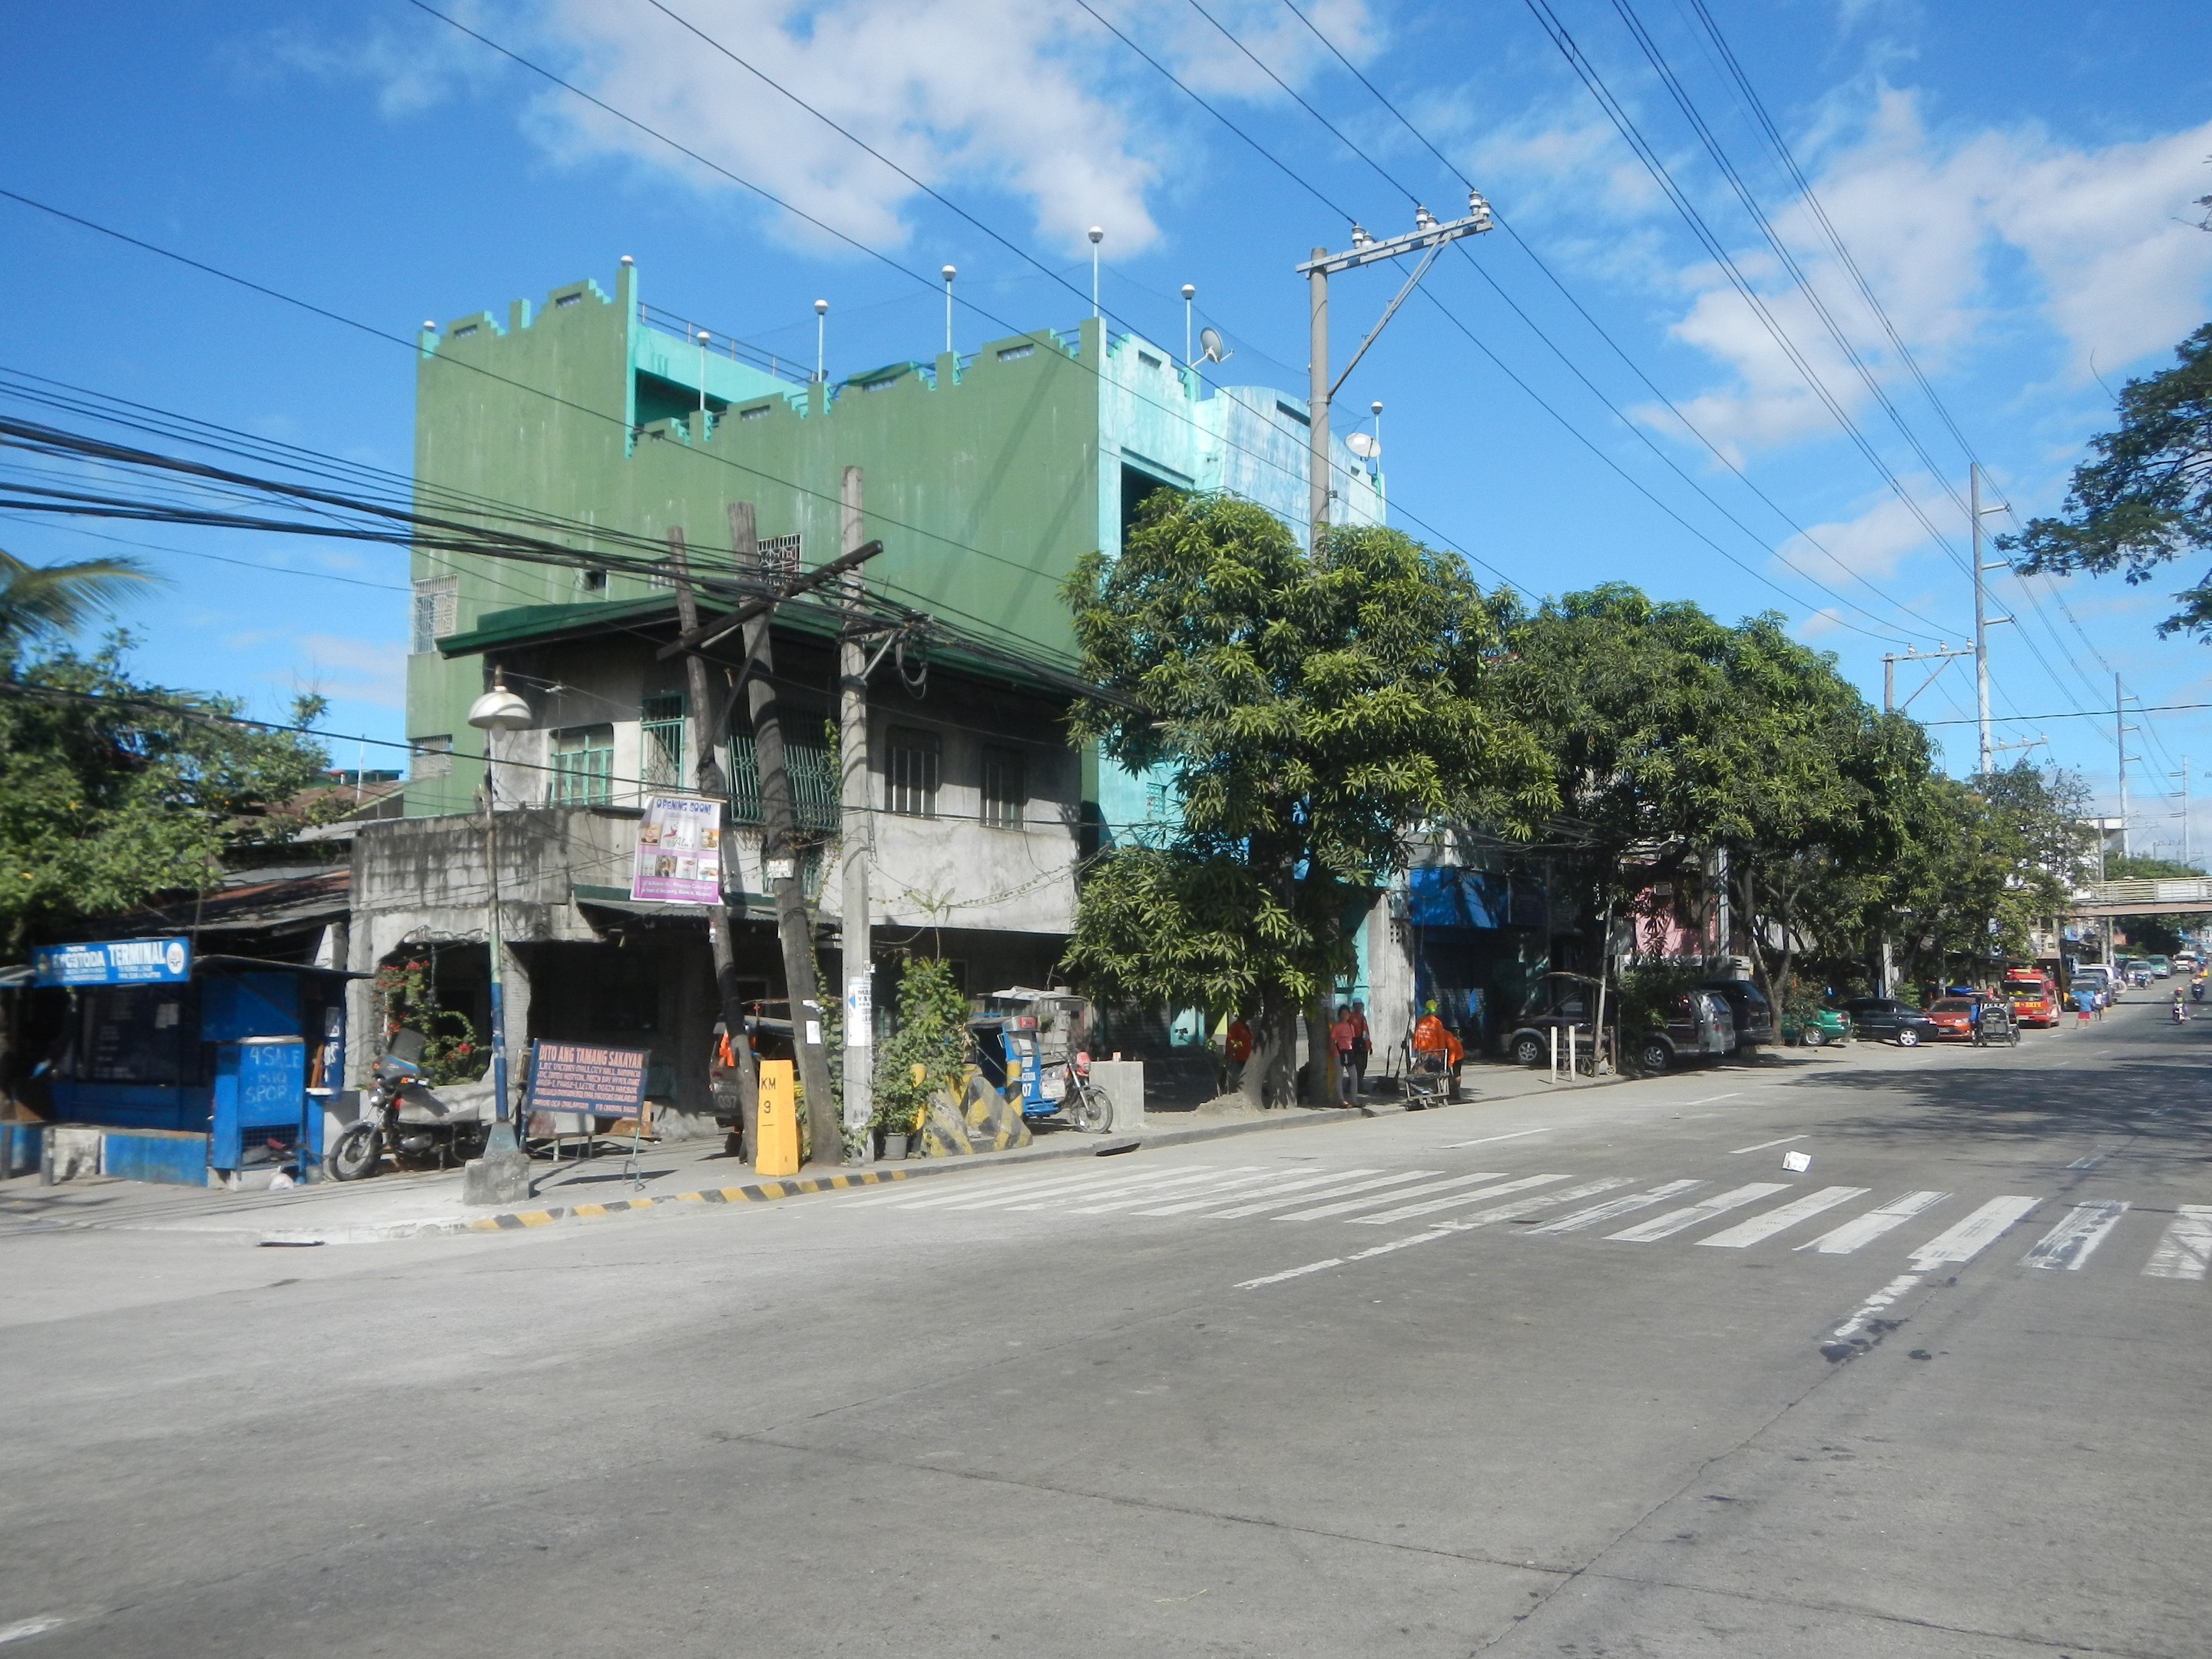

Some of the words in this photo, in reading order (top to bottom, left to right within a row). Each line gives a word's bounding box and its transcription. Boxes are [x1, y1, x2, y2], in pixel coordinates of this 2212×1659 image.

[656, 799, 687, 811] OPENING
[689, 801, 712, 815] SOON!
[107, 941, 166, 966] TERMINAL
[250, 1046, 259, 1065] 4
[262, 1046, 301, 1068] SALE
[538, 1045, 557, 1061] DITO
[558, 1045, 575, 1062] ANG
[576, 1048, 608, 1065] TAMANG
[608, 1051, 644, 1068] SAKAYAN
[761, 1078, 776, 1090] KM
[1022, 1083, 1032, 1097] 07
[763, 1100, 771, 1114] 9
